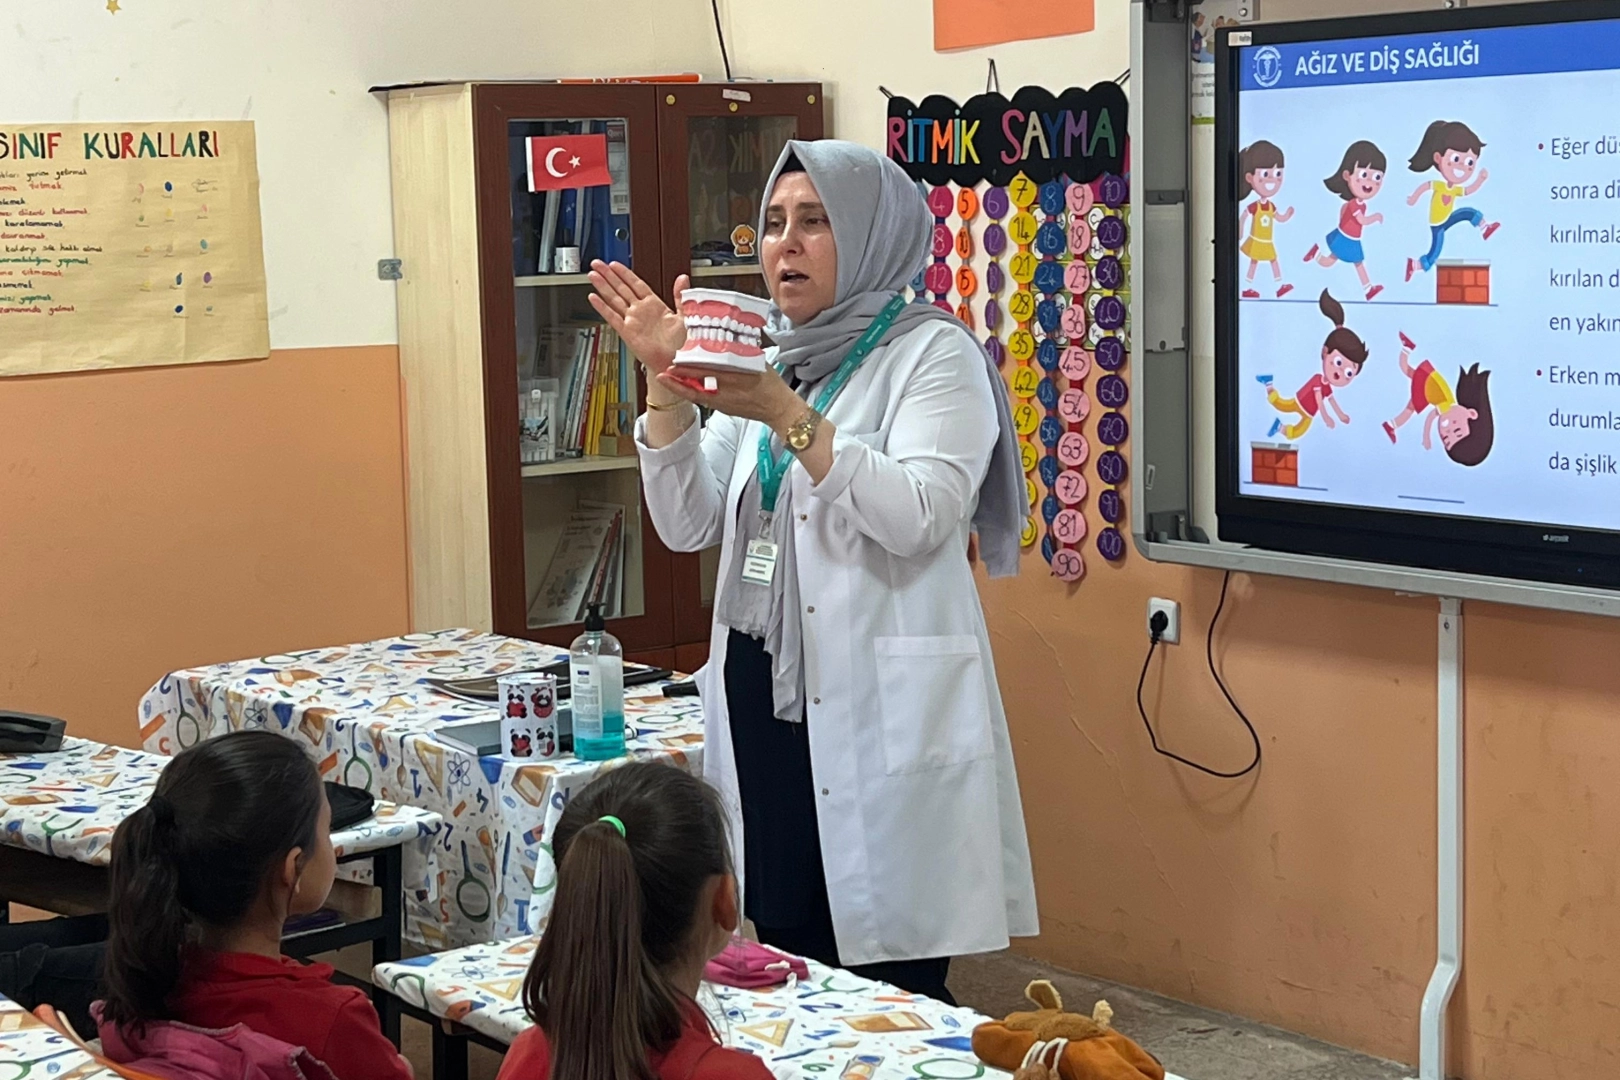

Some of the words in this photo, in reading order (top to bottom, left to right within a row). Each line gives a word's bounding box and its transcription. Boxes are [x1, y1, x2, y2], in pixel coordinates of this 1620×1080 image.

[1295, 51, 1337, 76] AĞIZ
[1341, 52, 1365, 73] VE
[1370, 45, 1399, 74] DİŞ
[1404, 40, 1479, 69] SAĞLIĞI
[84, 130, 219, 160] KURALLARI
[888, 108, 980, 165] RİTMİK
[1000, 107, 1116, 165] SAYMA
[1551, 136, 1590, 160] Eğer
[1595, 134, 1620, 155] dü
[932, 189, 945, 212] 4
[1016, 178, 1028, 202] 7
[1047, 181, 1057, 213] 8
[1072, 184, 1086, 212] 9
[1104, 177, 1121, 201] 10
[1551, 184, 1599, 200] sonra
[961, 190, 969, 214] 5
[987, 189, 1000, 214] 6
[933, 227, 945, 253] 8
[987, 228, 1000, 252] 12
[1014, 217, 1030, 240] 14
[1042, 225, 1058, 249] 16
[1071, 225, 1085, 249] 18
[1101, 221, 1121, 243] 20
[931, 265, 947, 290] 12
[1014, 256, 1032, 277] 21
[1039, 264, 1056, 287] 24
[1069, 265, 1089, 288] 27
[1097, 259, 1119, 284] 30
[1550, 267, 1603, 288] kırılan
[1012, 293, 1031, 315] 28
[1099, 300, 1121, 324] 40
[1066, 307, 1083, 334] 36
[1549, 316, 1570, 331] en
[1012, 331, 1029, 355] 35
[1099, 341, 1121, 366] 50
[1062, 349, 1086, 373] 45
[1014, 370, 1035, 393] 42
[1550, 365, 1598, 385] Erken
[1100, 378, 1125, 403] 60
[1062, 392, 1085, 418] 54
[1014, 406, 1031, 430] 49
[1101, 417, 1125, 441] 70
[1061, 435, 1083, 460] 63
[1099, 455, 1122, 481] 80
[1549, 451, 1570, 470] da
[1575, 453, 1617, 477] şişlik
[1060, 475, 1081, 499] 72
[1058, 513, 1078, 537] 81
[1054, 553, 1081, 577] 90
